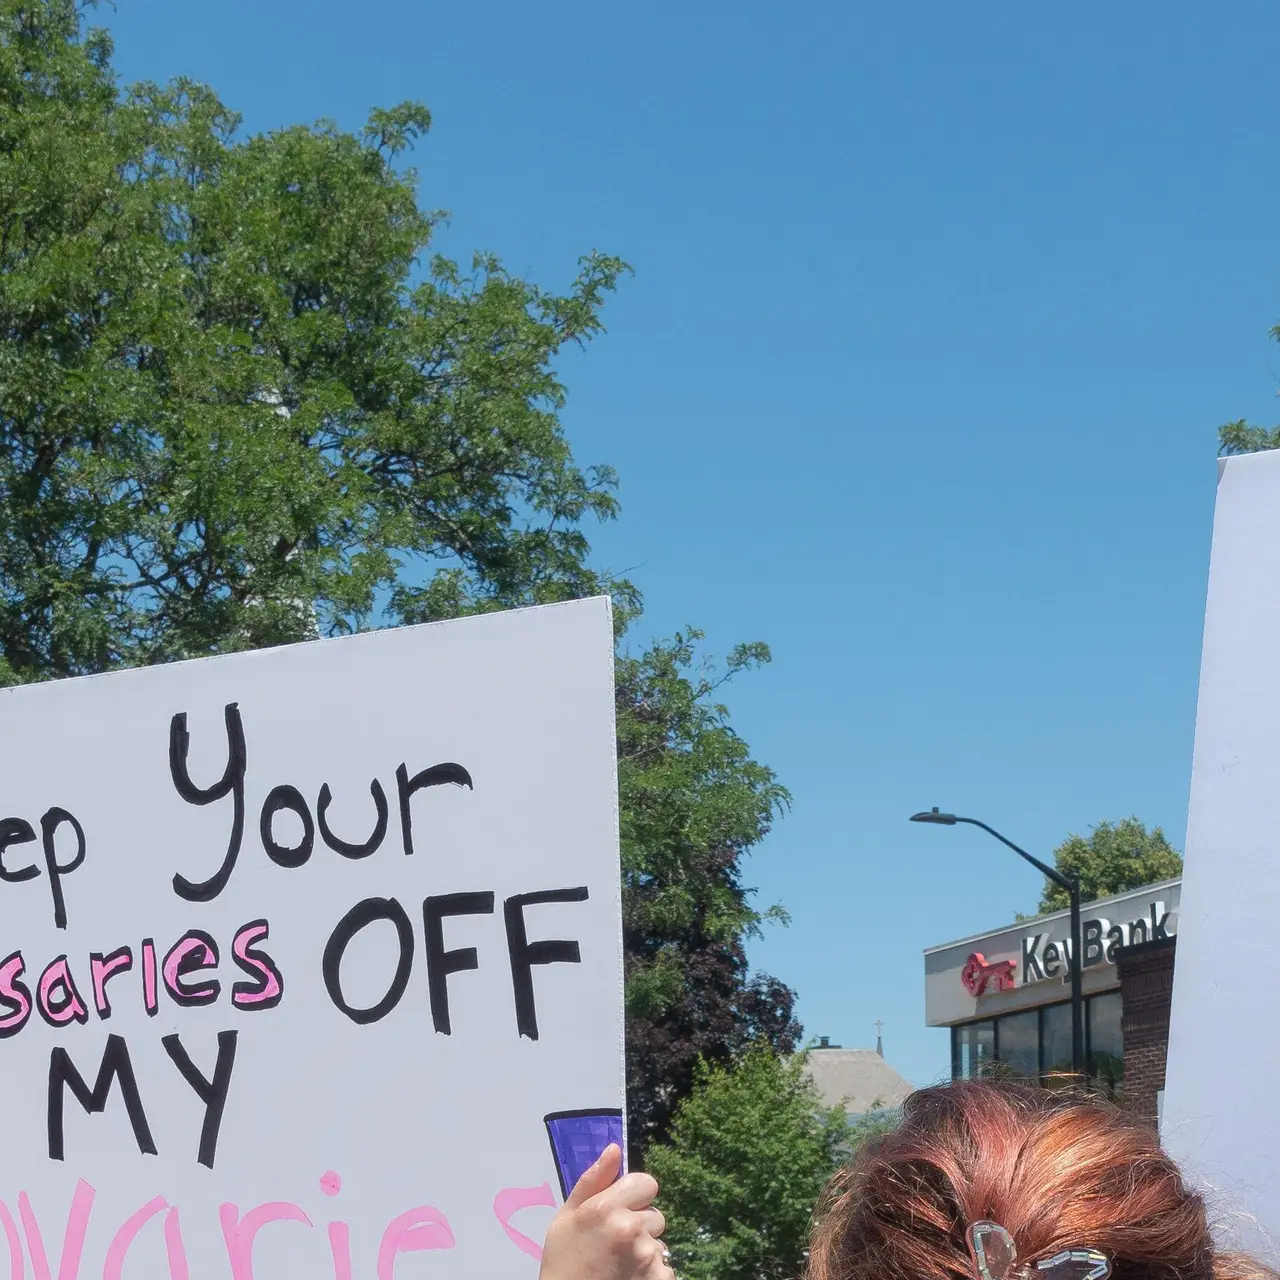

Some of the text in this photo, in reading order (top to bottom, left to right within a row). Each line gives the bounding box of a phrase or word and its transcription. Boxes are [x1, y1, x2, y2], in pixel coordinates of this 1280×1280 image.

[168, 702, 474, 902] Your
[321, 886, 589, 1042] OFF
[47, 1029, 238, 1169] MY
